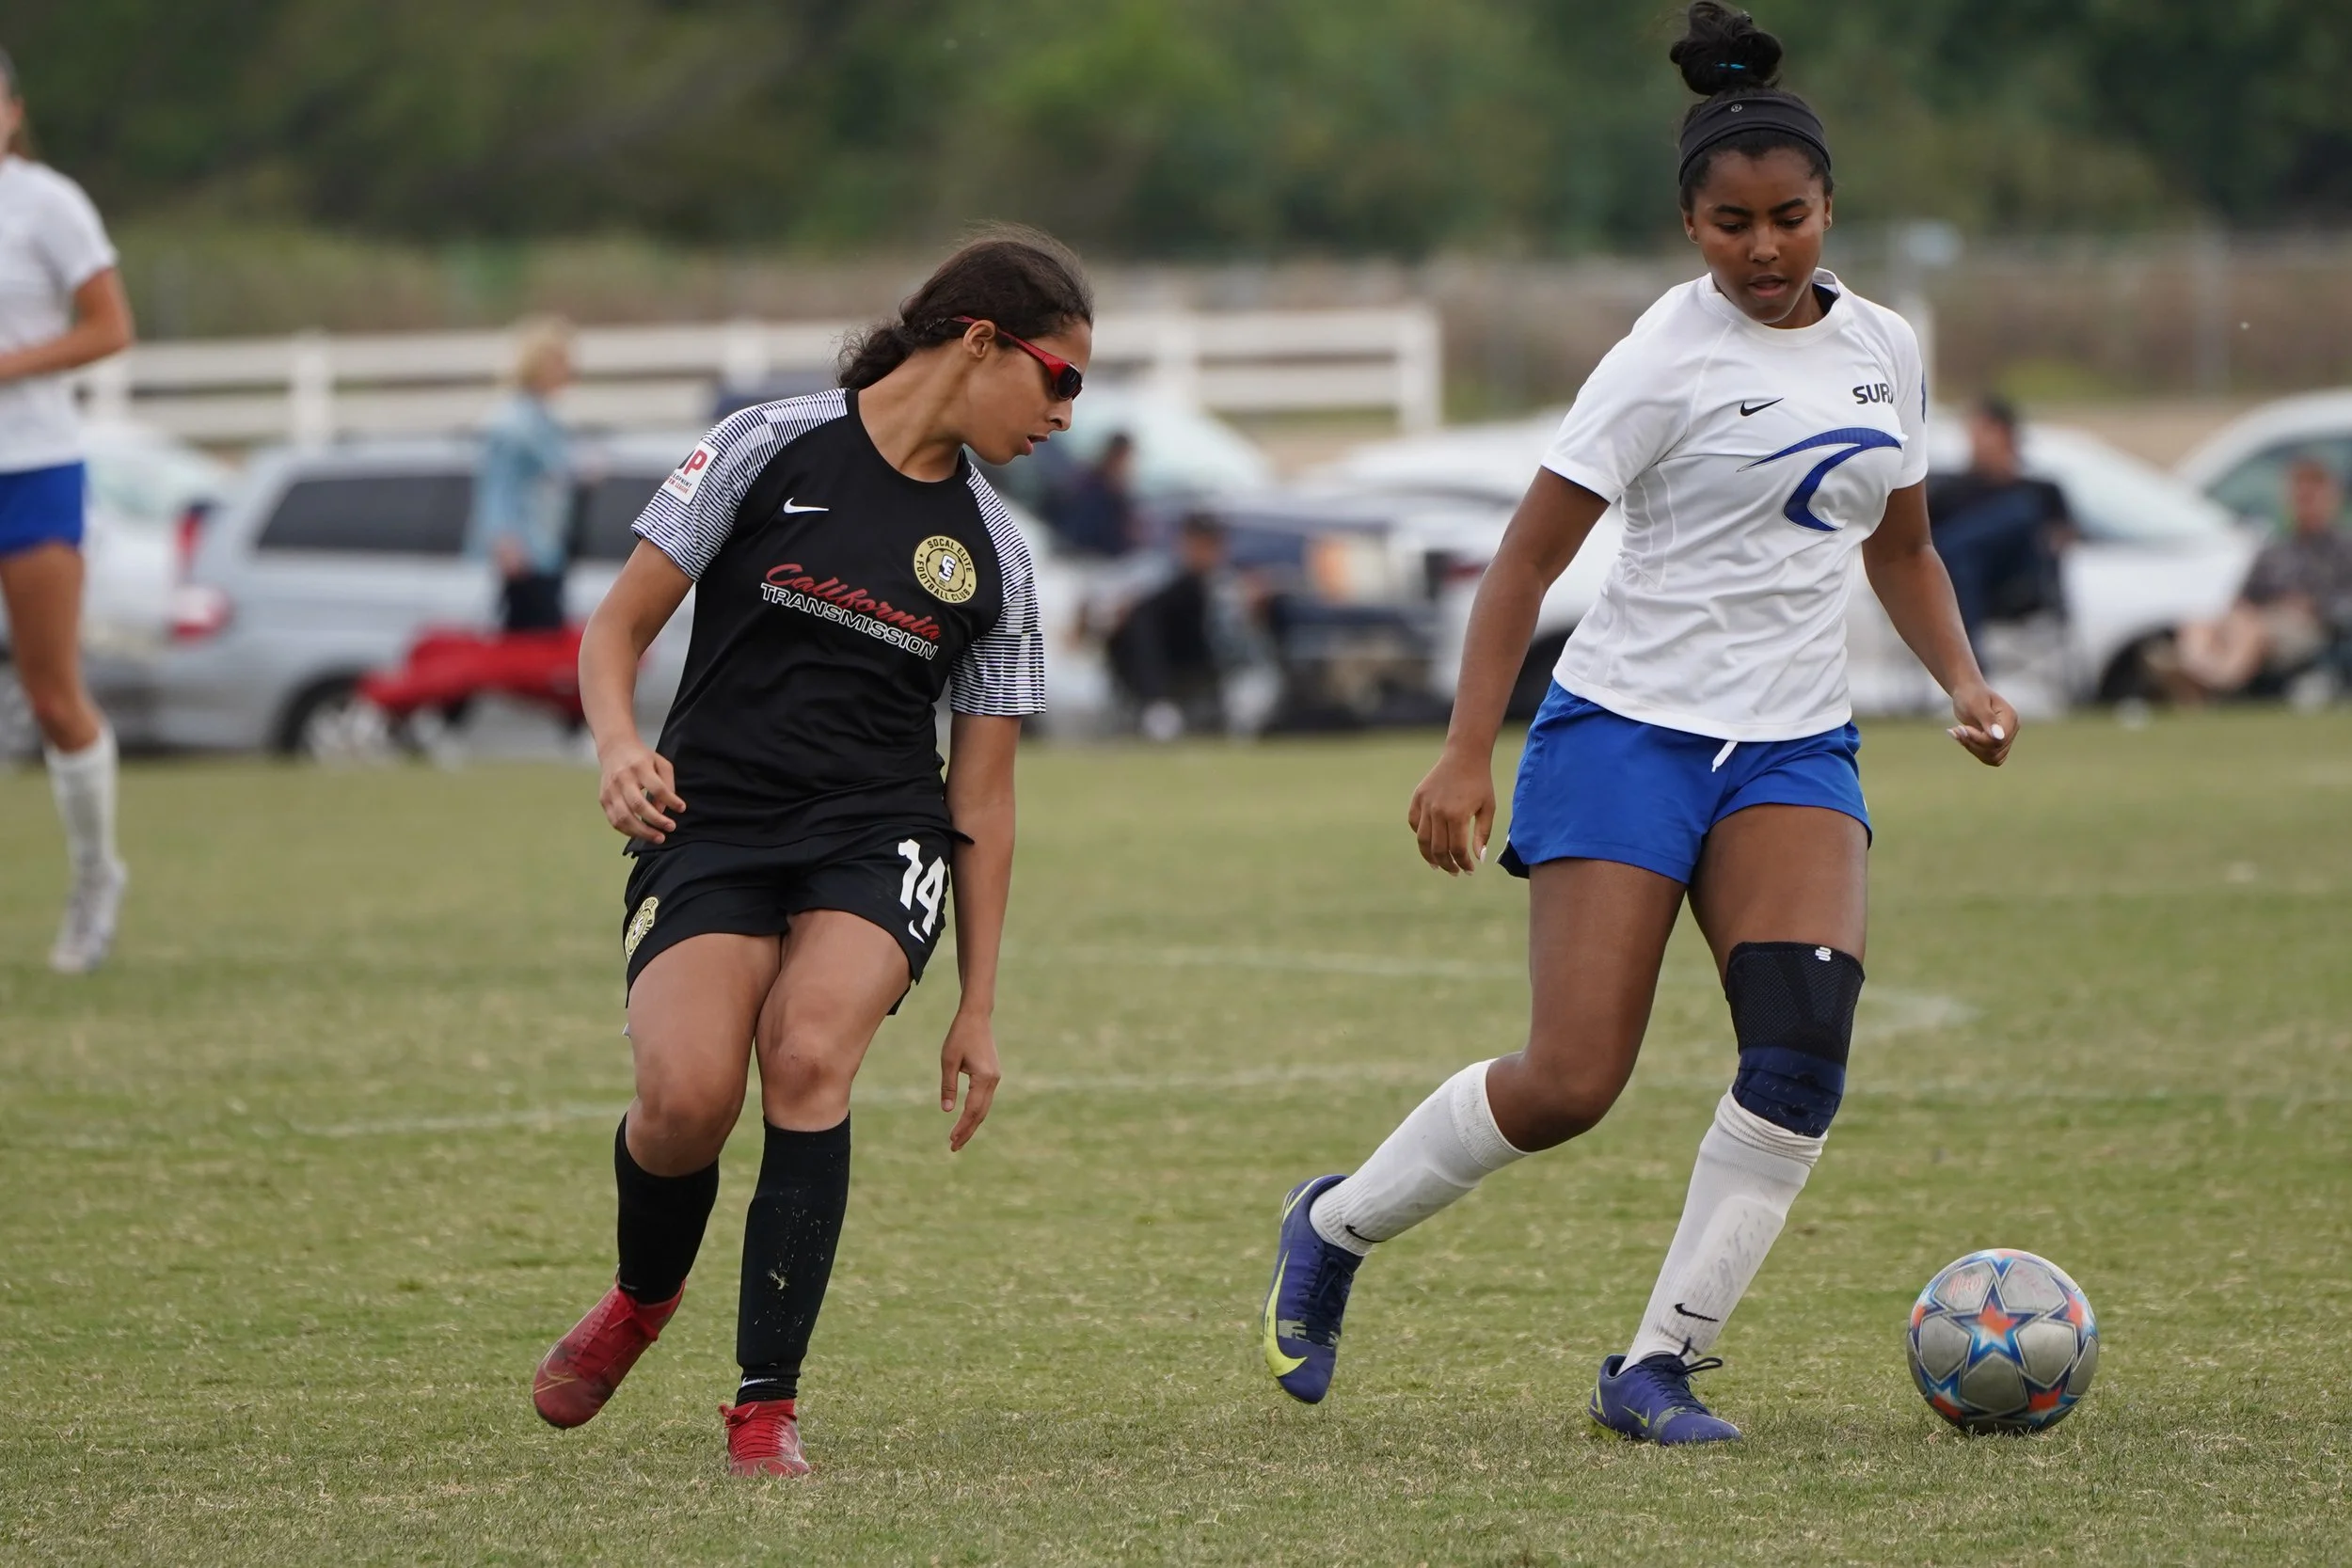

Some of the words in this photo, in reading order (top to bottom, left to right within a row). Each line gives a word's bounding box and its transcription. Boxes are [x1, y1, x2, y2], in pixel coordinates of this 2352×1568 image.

[916, 560, 949, 600] FOOTBALL
[951, 588, 971, 601] CLUB
[927, 538, 954, 550] SOCAL
[957, 547, 973, 573] ELITE
[760, 582, 938, 660] TRANSMISSION
[766, 563, 941, 641] California
[898, 838, 946, 937] 14
